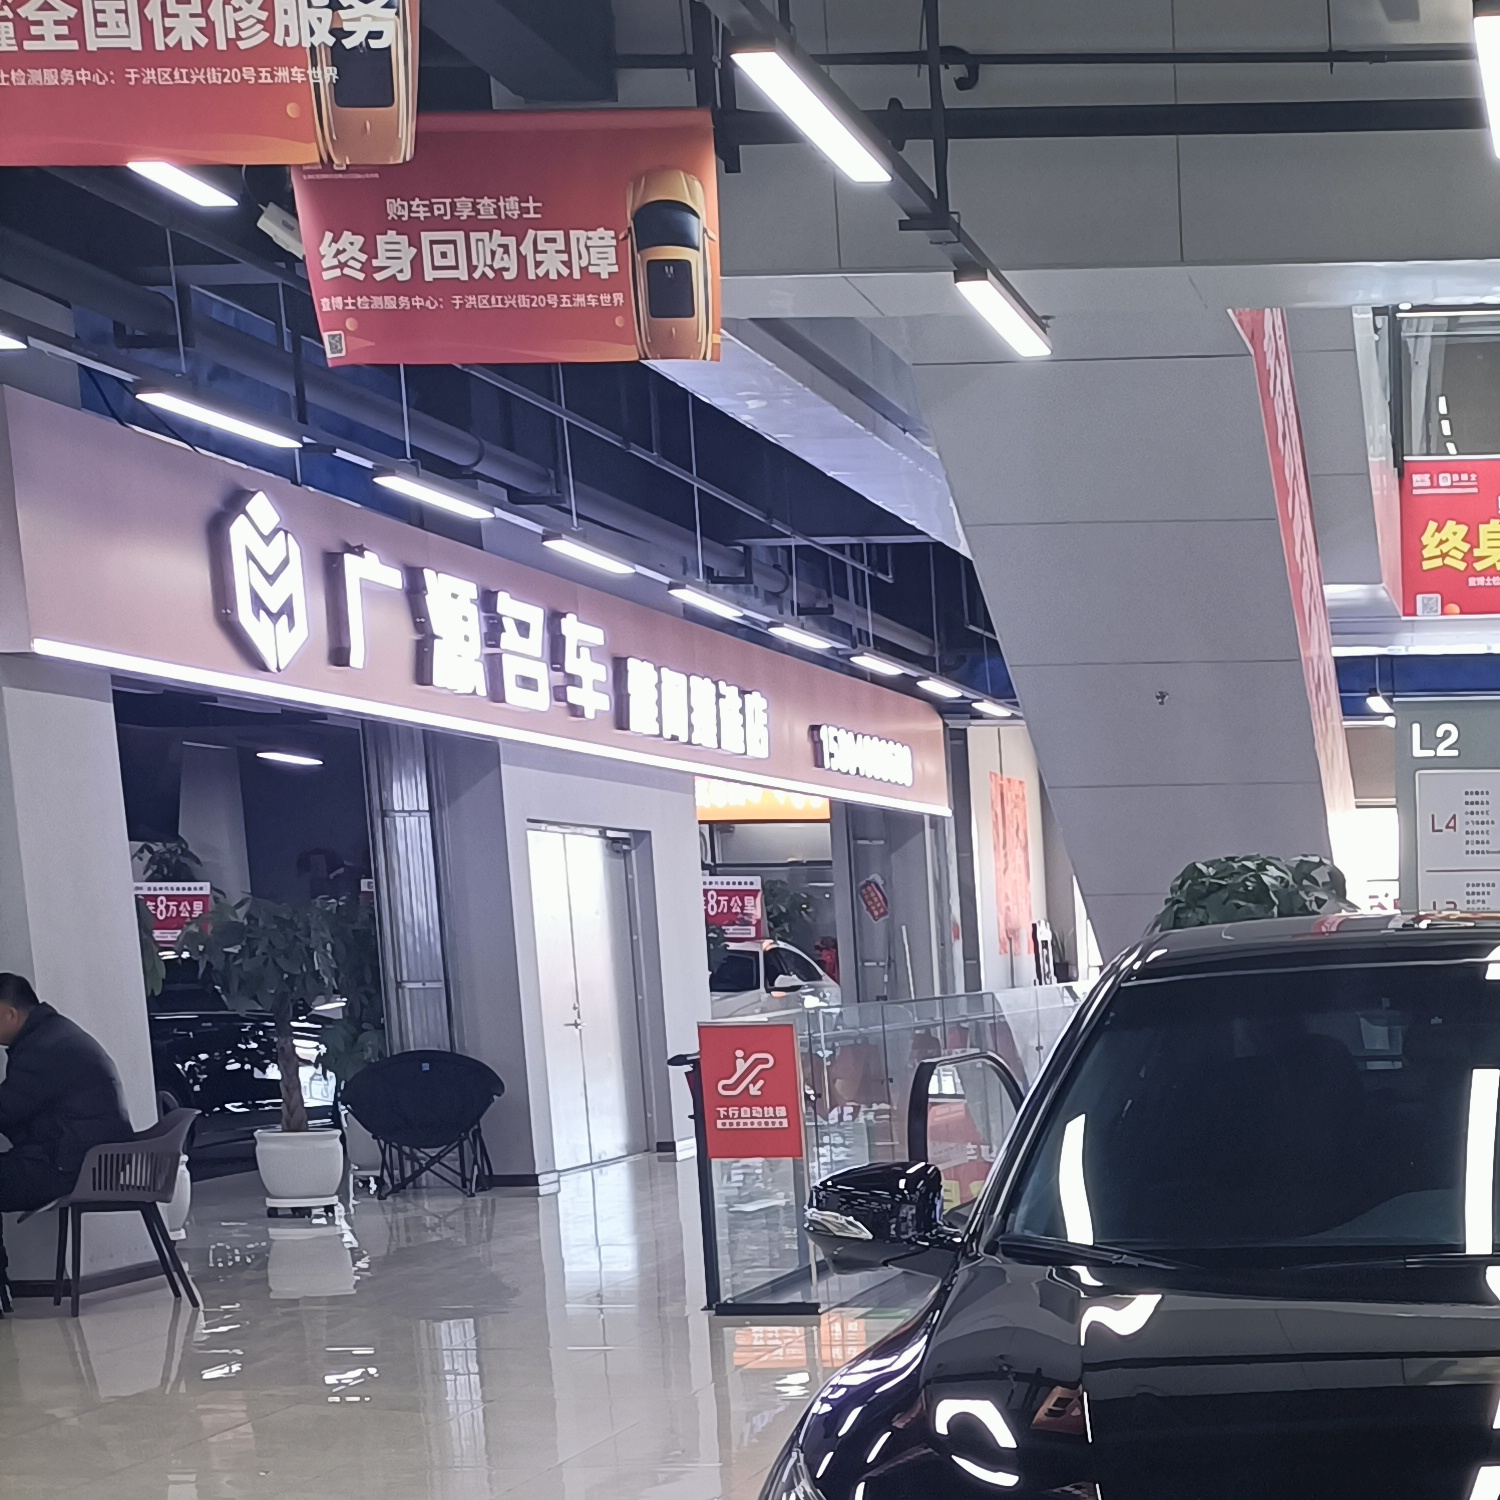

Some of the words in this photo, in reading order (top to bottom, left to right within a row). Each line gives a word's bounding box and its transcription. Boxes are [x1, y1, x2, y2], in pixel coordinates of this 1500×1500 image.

[386, 195, 543, 221] 购车可享查博士
[318, 226, 619, 282] 终身回购保障
[1411, 722, 1460, 758] L2
[1431, 813, 1457, 833] L4
